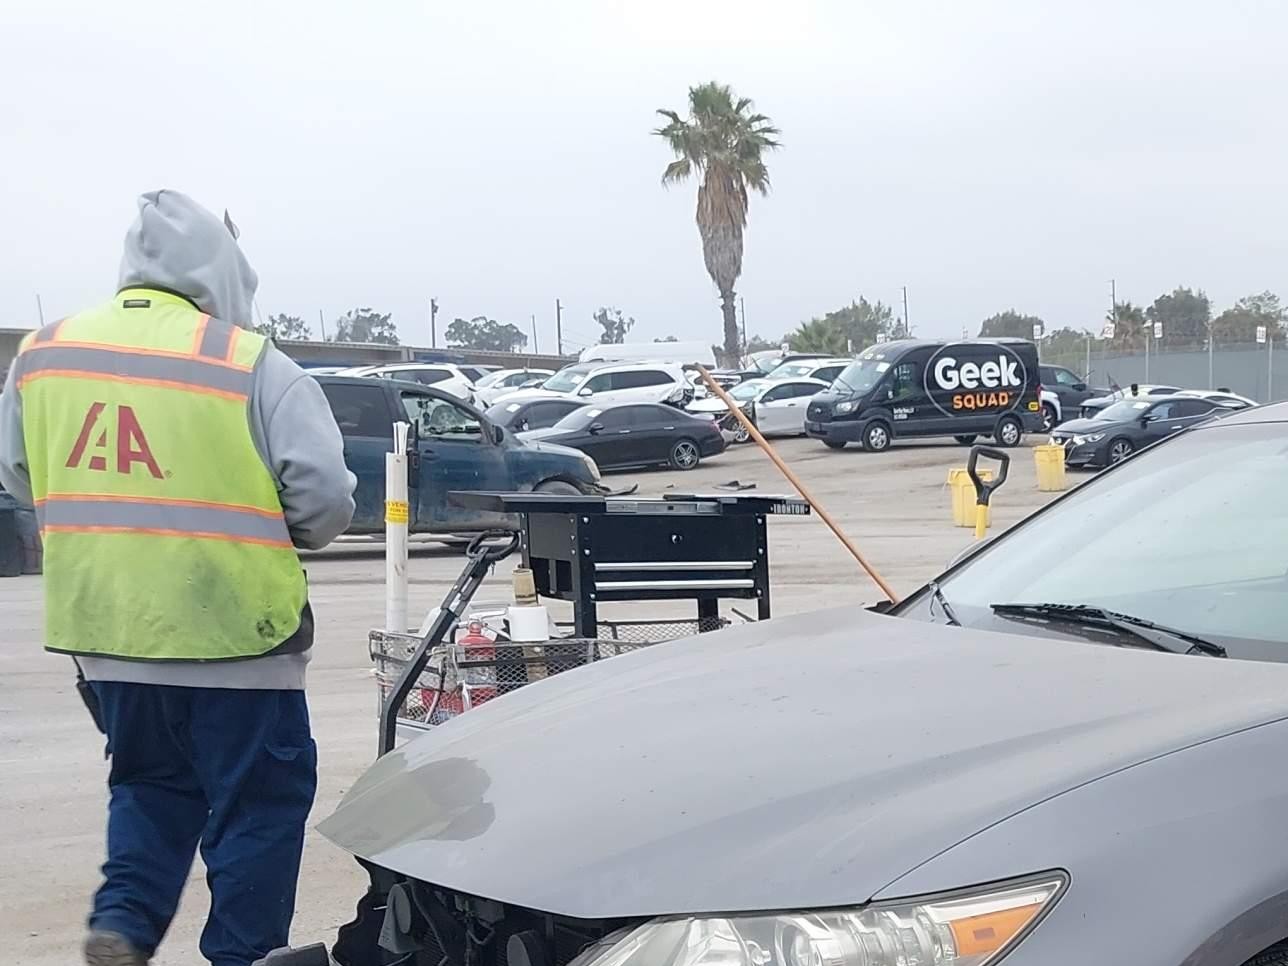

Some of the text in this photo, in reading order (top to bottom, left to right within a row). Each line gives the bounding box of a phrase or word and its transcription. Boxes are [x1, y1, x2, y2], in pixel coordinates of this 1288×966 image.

[934, 355, 1021, 390] Geek
[952, 392, 1010, 410] SQUAD
[773, 503, 805, 514] IRONTON
